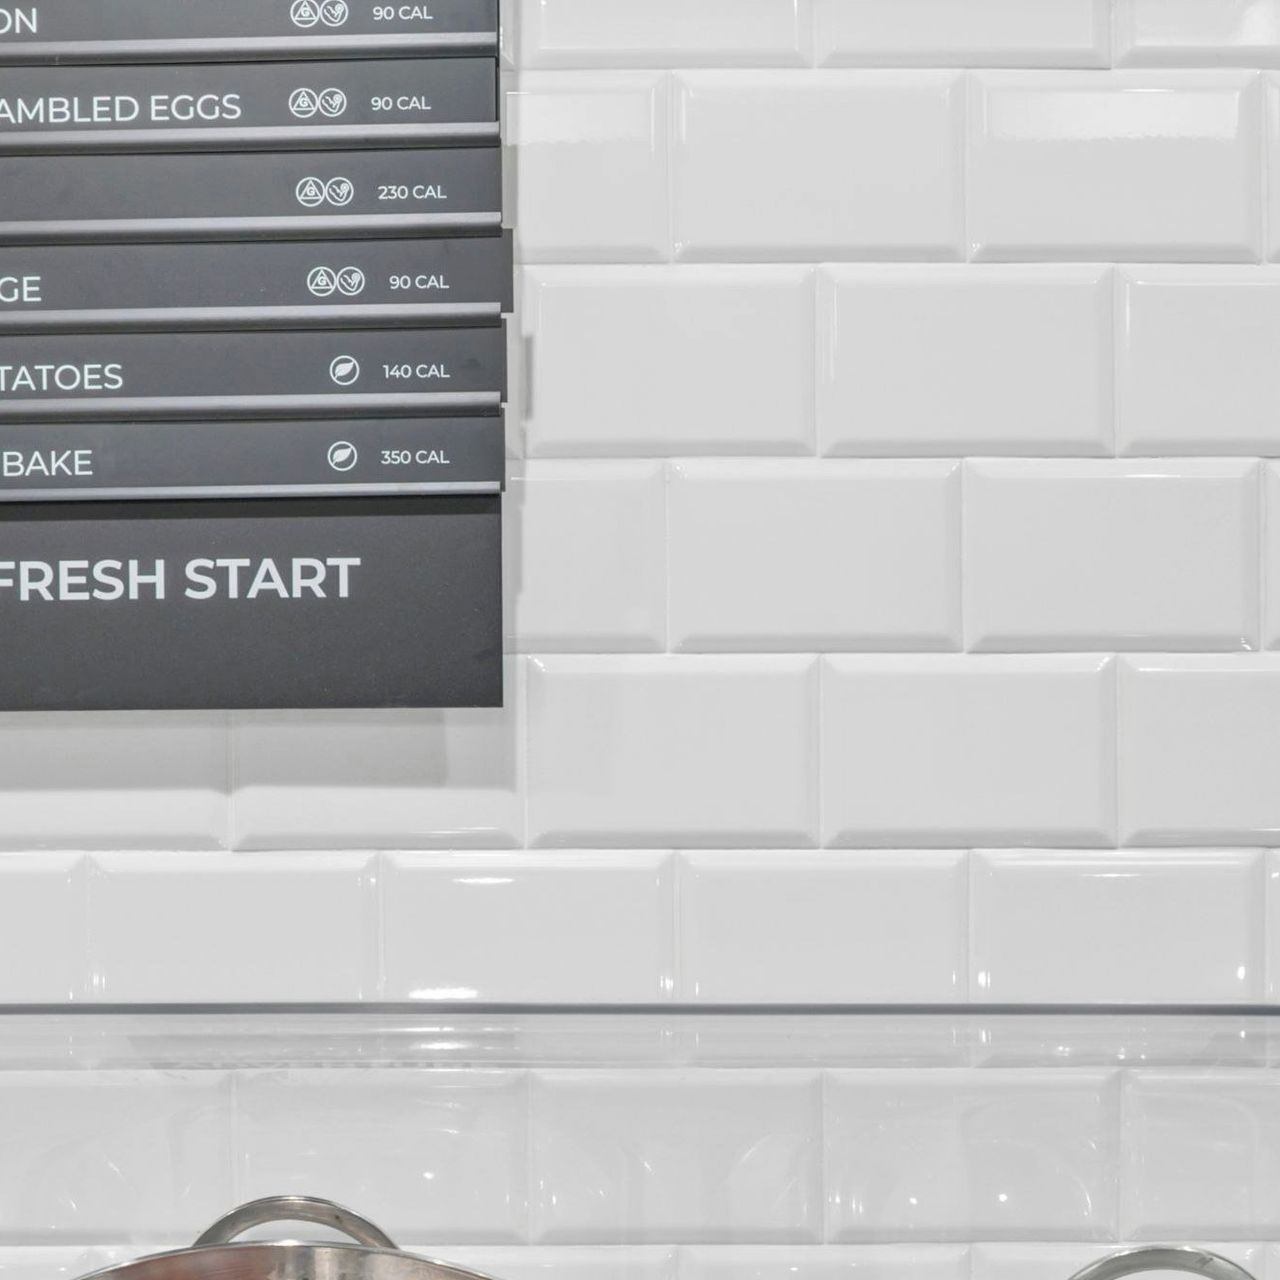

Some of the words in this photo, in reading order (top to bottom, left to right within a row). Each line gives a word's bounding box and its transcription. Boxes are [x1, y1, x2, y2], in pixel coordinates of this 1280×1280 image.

[373, 7, 394, 20] 90
[399, 6, 432, 19] CAL
[150, 94, 242, 122] EGGS
[371, 97, 392, 110] 90
[397, 96, 431, 110] CAL
[378, 186, 408, 199] 230
[413, 185, 447, 199] CAL
[390, 276, 411, 289] 90
[415, 275, 449, 288] CAL
[383, 365, 411, 378] 140
[416, 365, 450, 378] CAL
[3, 450, 92, 476] BAKE
[381, 451, 411, 464] 350
[416, 451, 449, 463] CAL
[185, 558, 360, 599] START
